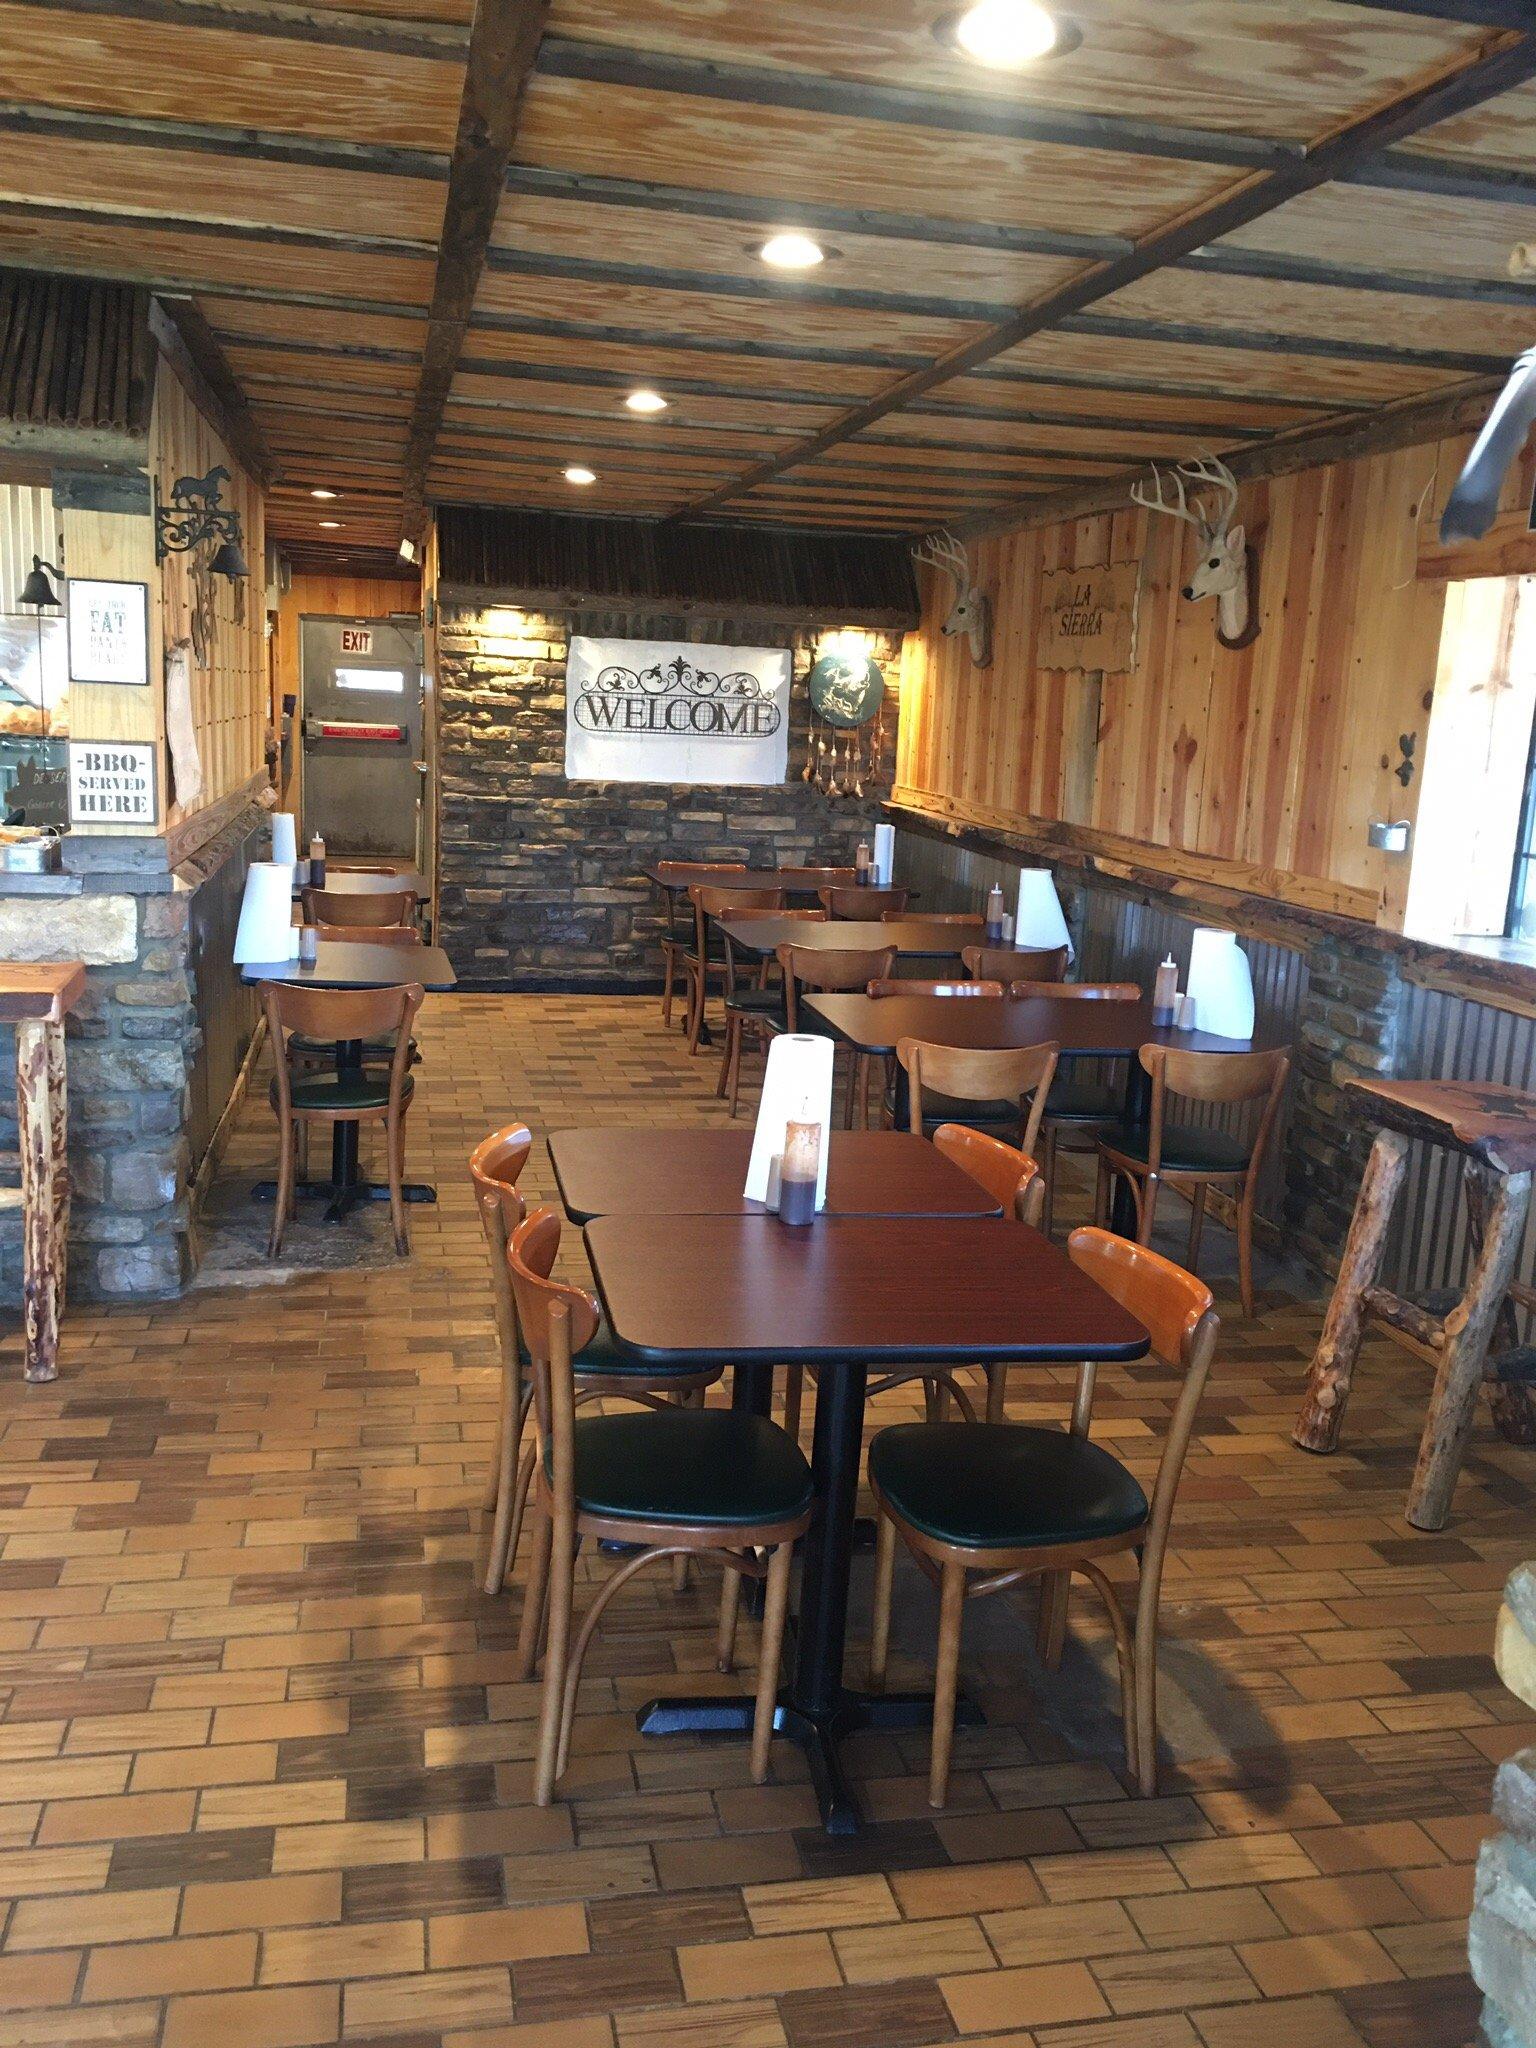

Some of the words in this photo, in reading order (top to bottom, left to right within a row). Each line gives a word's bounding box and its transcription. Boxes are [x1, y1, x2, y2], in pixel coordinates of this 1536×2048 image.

[1073, 584, 1091, 607] LA
[90, 610, 126, 634] FAT
[1060, 613, 1103, 636] SIERRA
[342, 630, 371, 651] EXIT
[583, 695, 773, 733] WELCOME
[78, 776, 146, 791] SERVED
[79, 794, 147, 813] HERE
